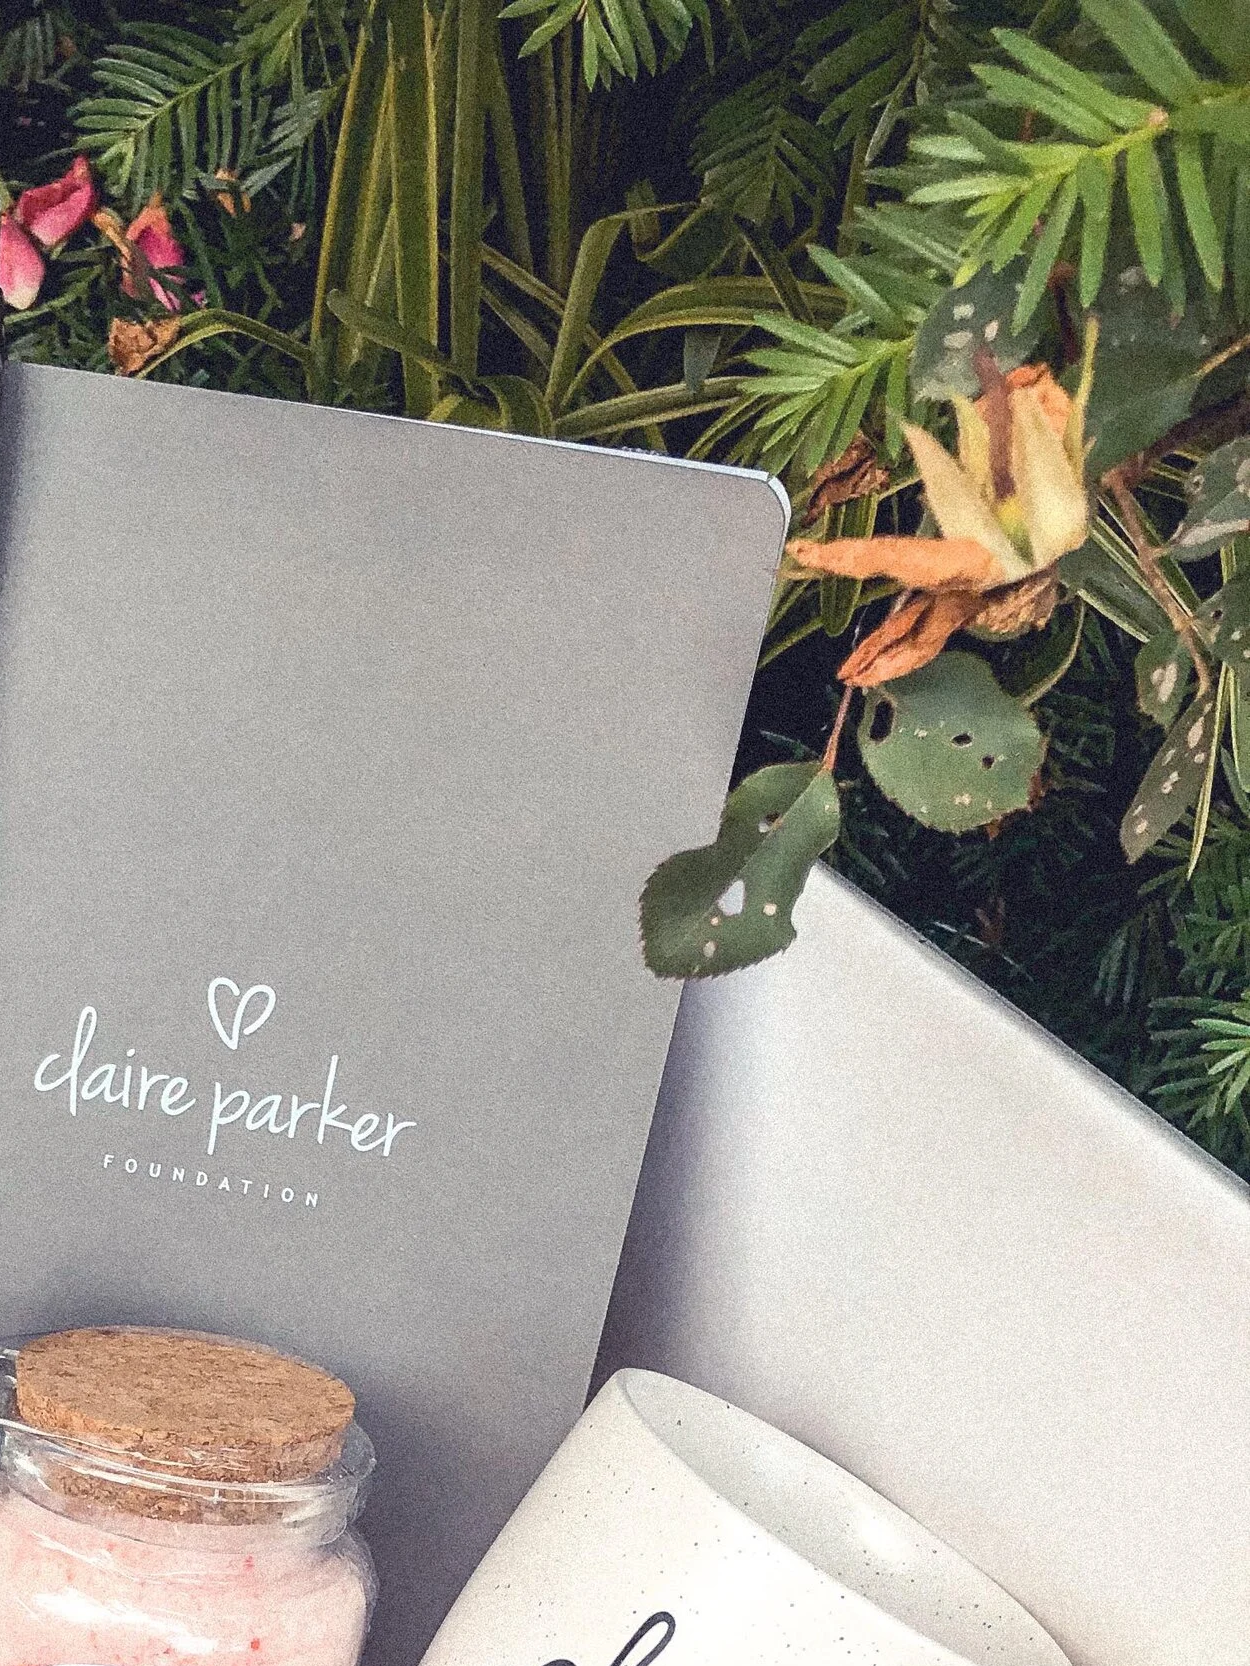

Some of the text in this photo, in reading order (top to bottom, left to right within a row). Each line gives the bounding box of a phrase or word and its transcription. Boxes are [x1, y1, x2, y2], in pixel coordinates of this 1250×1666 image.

[34, 1005, 417, 1156] claire parker
[103, 1154, 319, 1208] FOUNDATION
